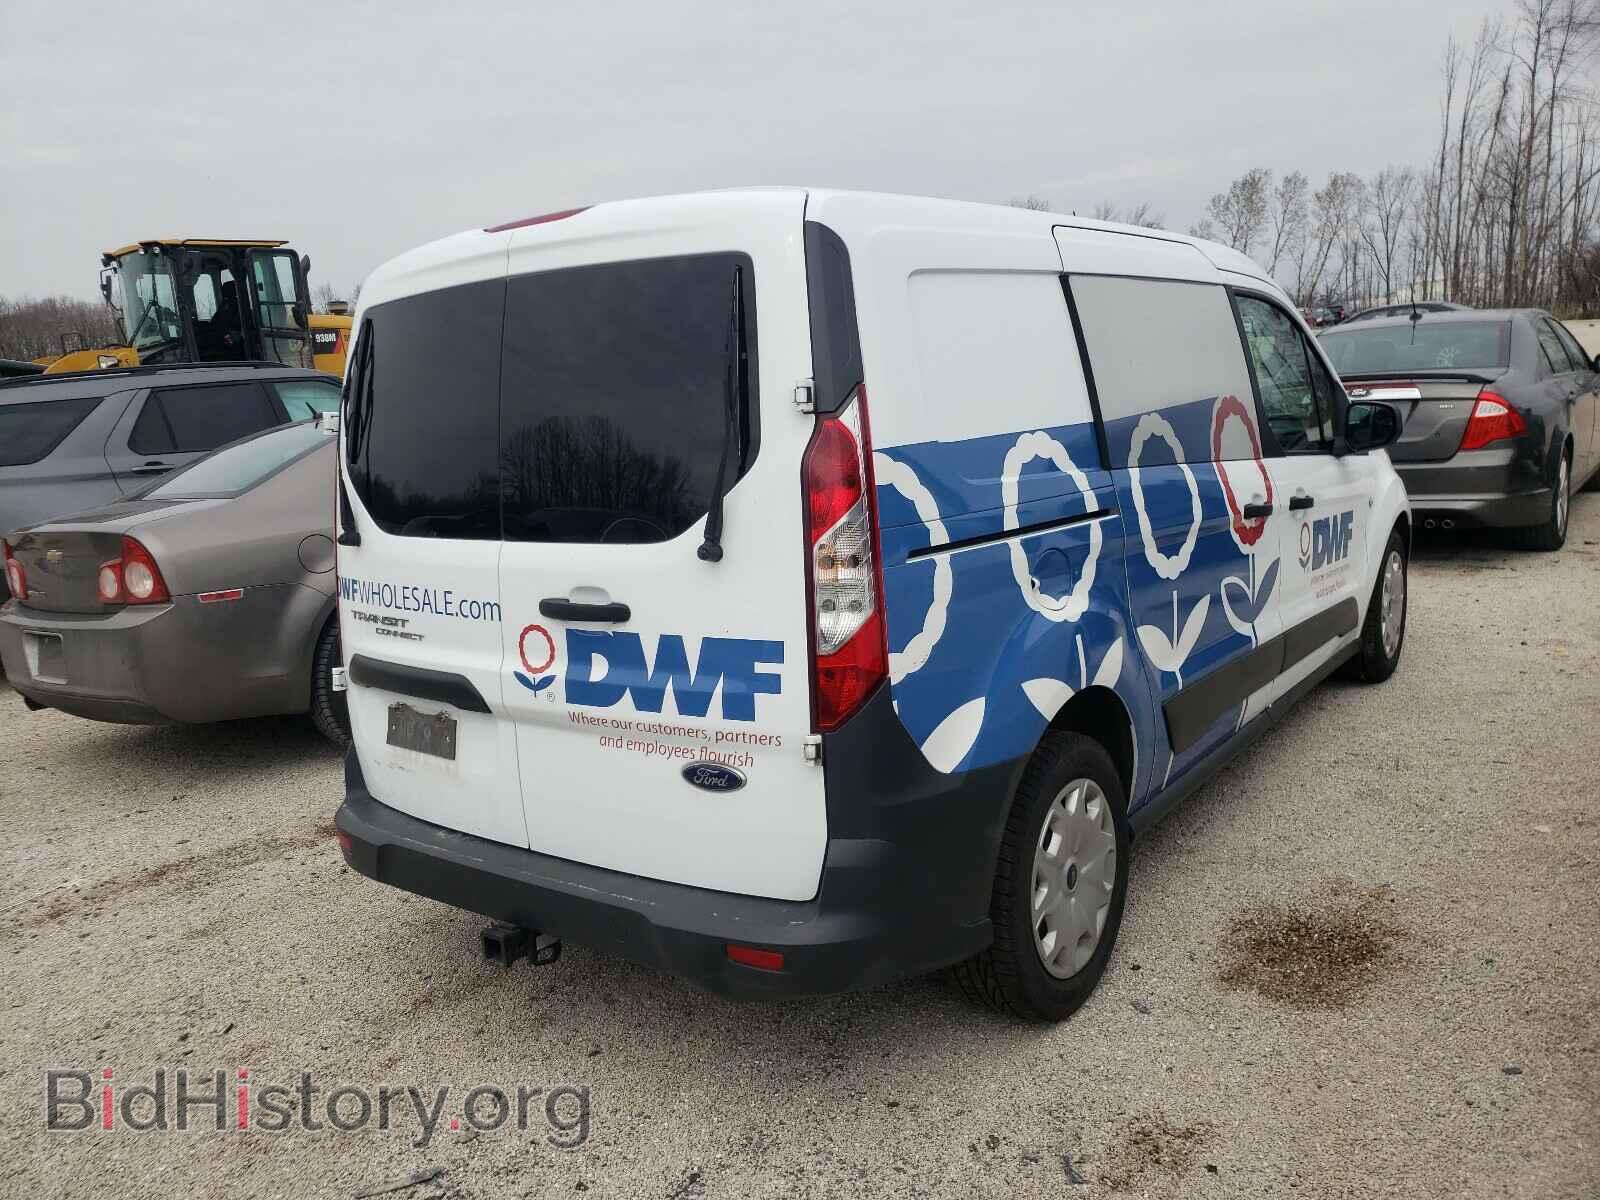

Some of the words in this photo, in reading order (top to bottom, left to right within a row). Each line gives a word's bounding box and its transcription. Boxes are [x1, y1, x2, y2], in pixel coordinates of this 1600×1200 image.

[1312, 510, 1354, 571] DWF
[351, 610, 410, 628] TRANSIT
[375, 627, 424, 642] CONNECT
[565, 628, 785, 722] DWF
[567, 711, 609, 728] Where
[611, 719, 633, 731] our
[636, 719, 712, 743] customers,
[715, 730, 782, 747] partners
[599, 735, 623, 749] and
[626, 740, 696, 761] employees
[699, 746, 754, 768] flourish
[693, 767, 728, 787] Ford
